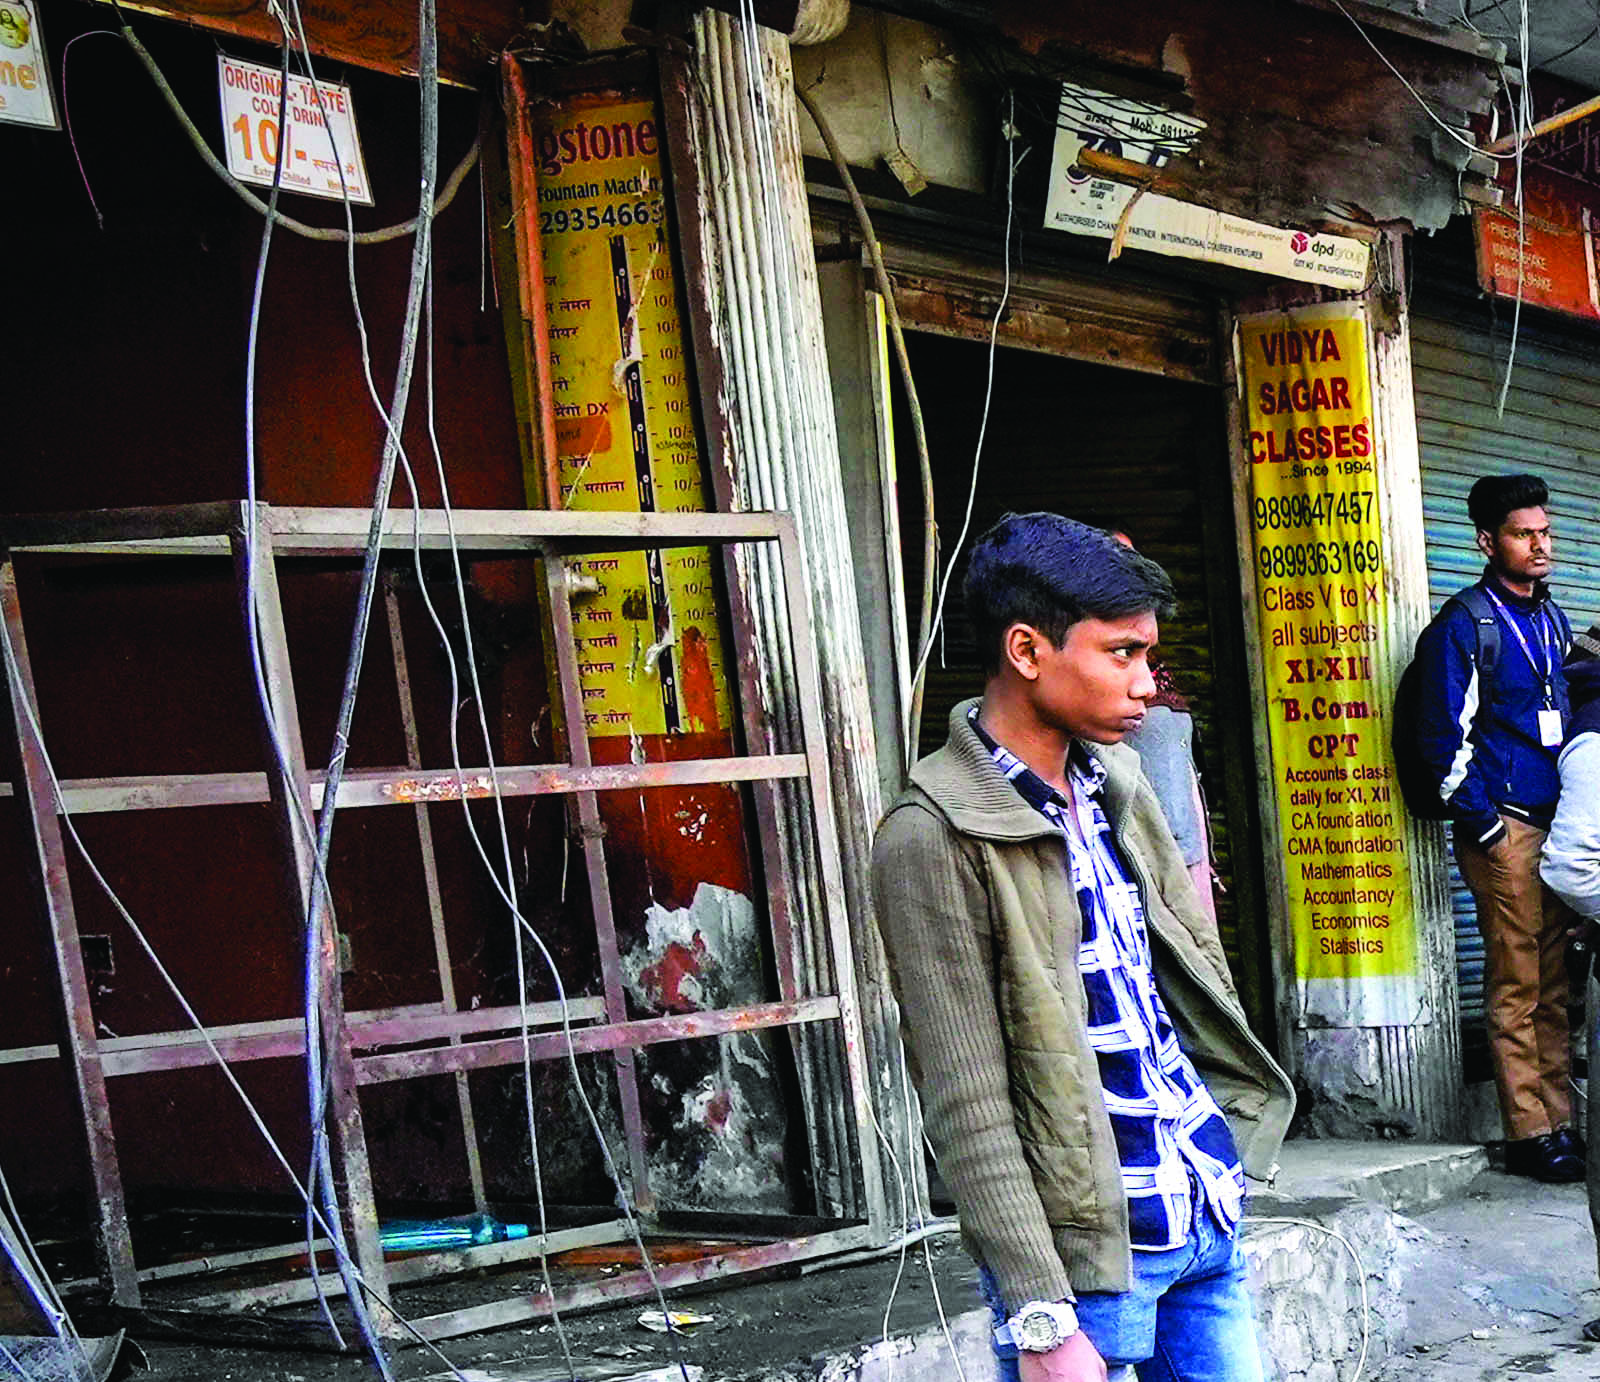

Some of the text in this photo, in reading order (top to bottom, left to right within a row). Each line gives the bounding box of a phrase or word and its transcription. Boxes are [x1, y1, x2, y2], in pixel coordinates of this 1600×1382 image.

[252, 96, 329, 128] COL DRIN
[533, 119, 658, 176] gstone
[604, 176, 660, 195] Machn
[1260, 328, 1341, 366] VIDYA
[1259, 376, 1351, 415] SAGAR
[587, 402, 608, 416] DX
[1251, 423, 1371, 464] CLASSES
[1335, 461, 1373, 476] 1994
[1254, 491, 1374, 531] 9899647457
[1259, 539, 1380, 579] 9899363169
[1263, 586, 1315, 612] Class
[1319, 584, 1332, 608] V
[1340, 584, 1358, 607] to
[1272, 619, 1377, 650] all subjects
[1308, 733, 1360, 760] CPT
[1285, 764, 1393, 784] Accounts class
[1290, 788, 1322, 808] daily
[1325, 786, 1345, 804] for
[1291, 809, 1394, 831] CA foundation
[1288, 833, 1405, 856] CMA foundation
[1301, 861, 1394, 881] Mathematics
[1304, 887, 1395, 908] Accountancy
[1311, 911, 1391, 930] Economics
[1320, 936, 1385, 955] Statistics
